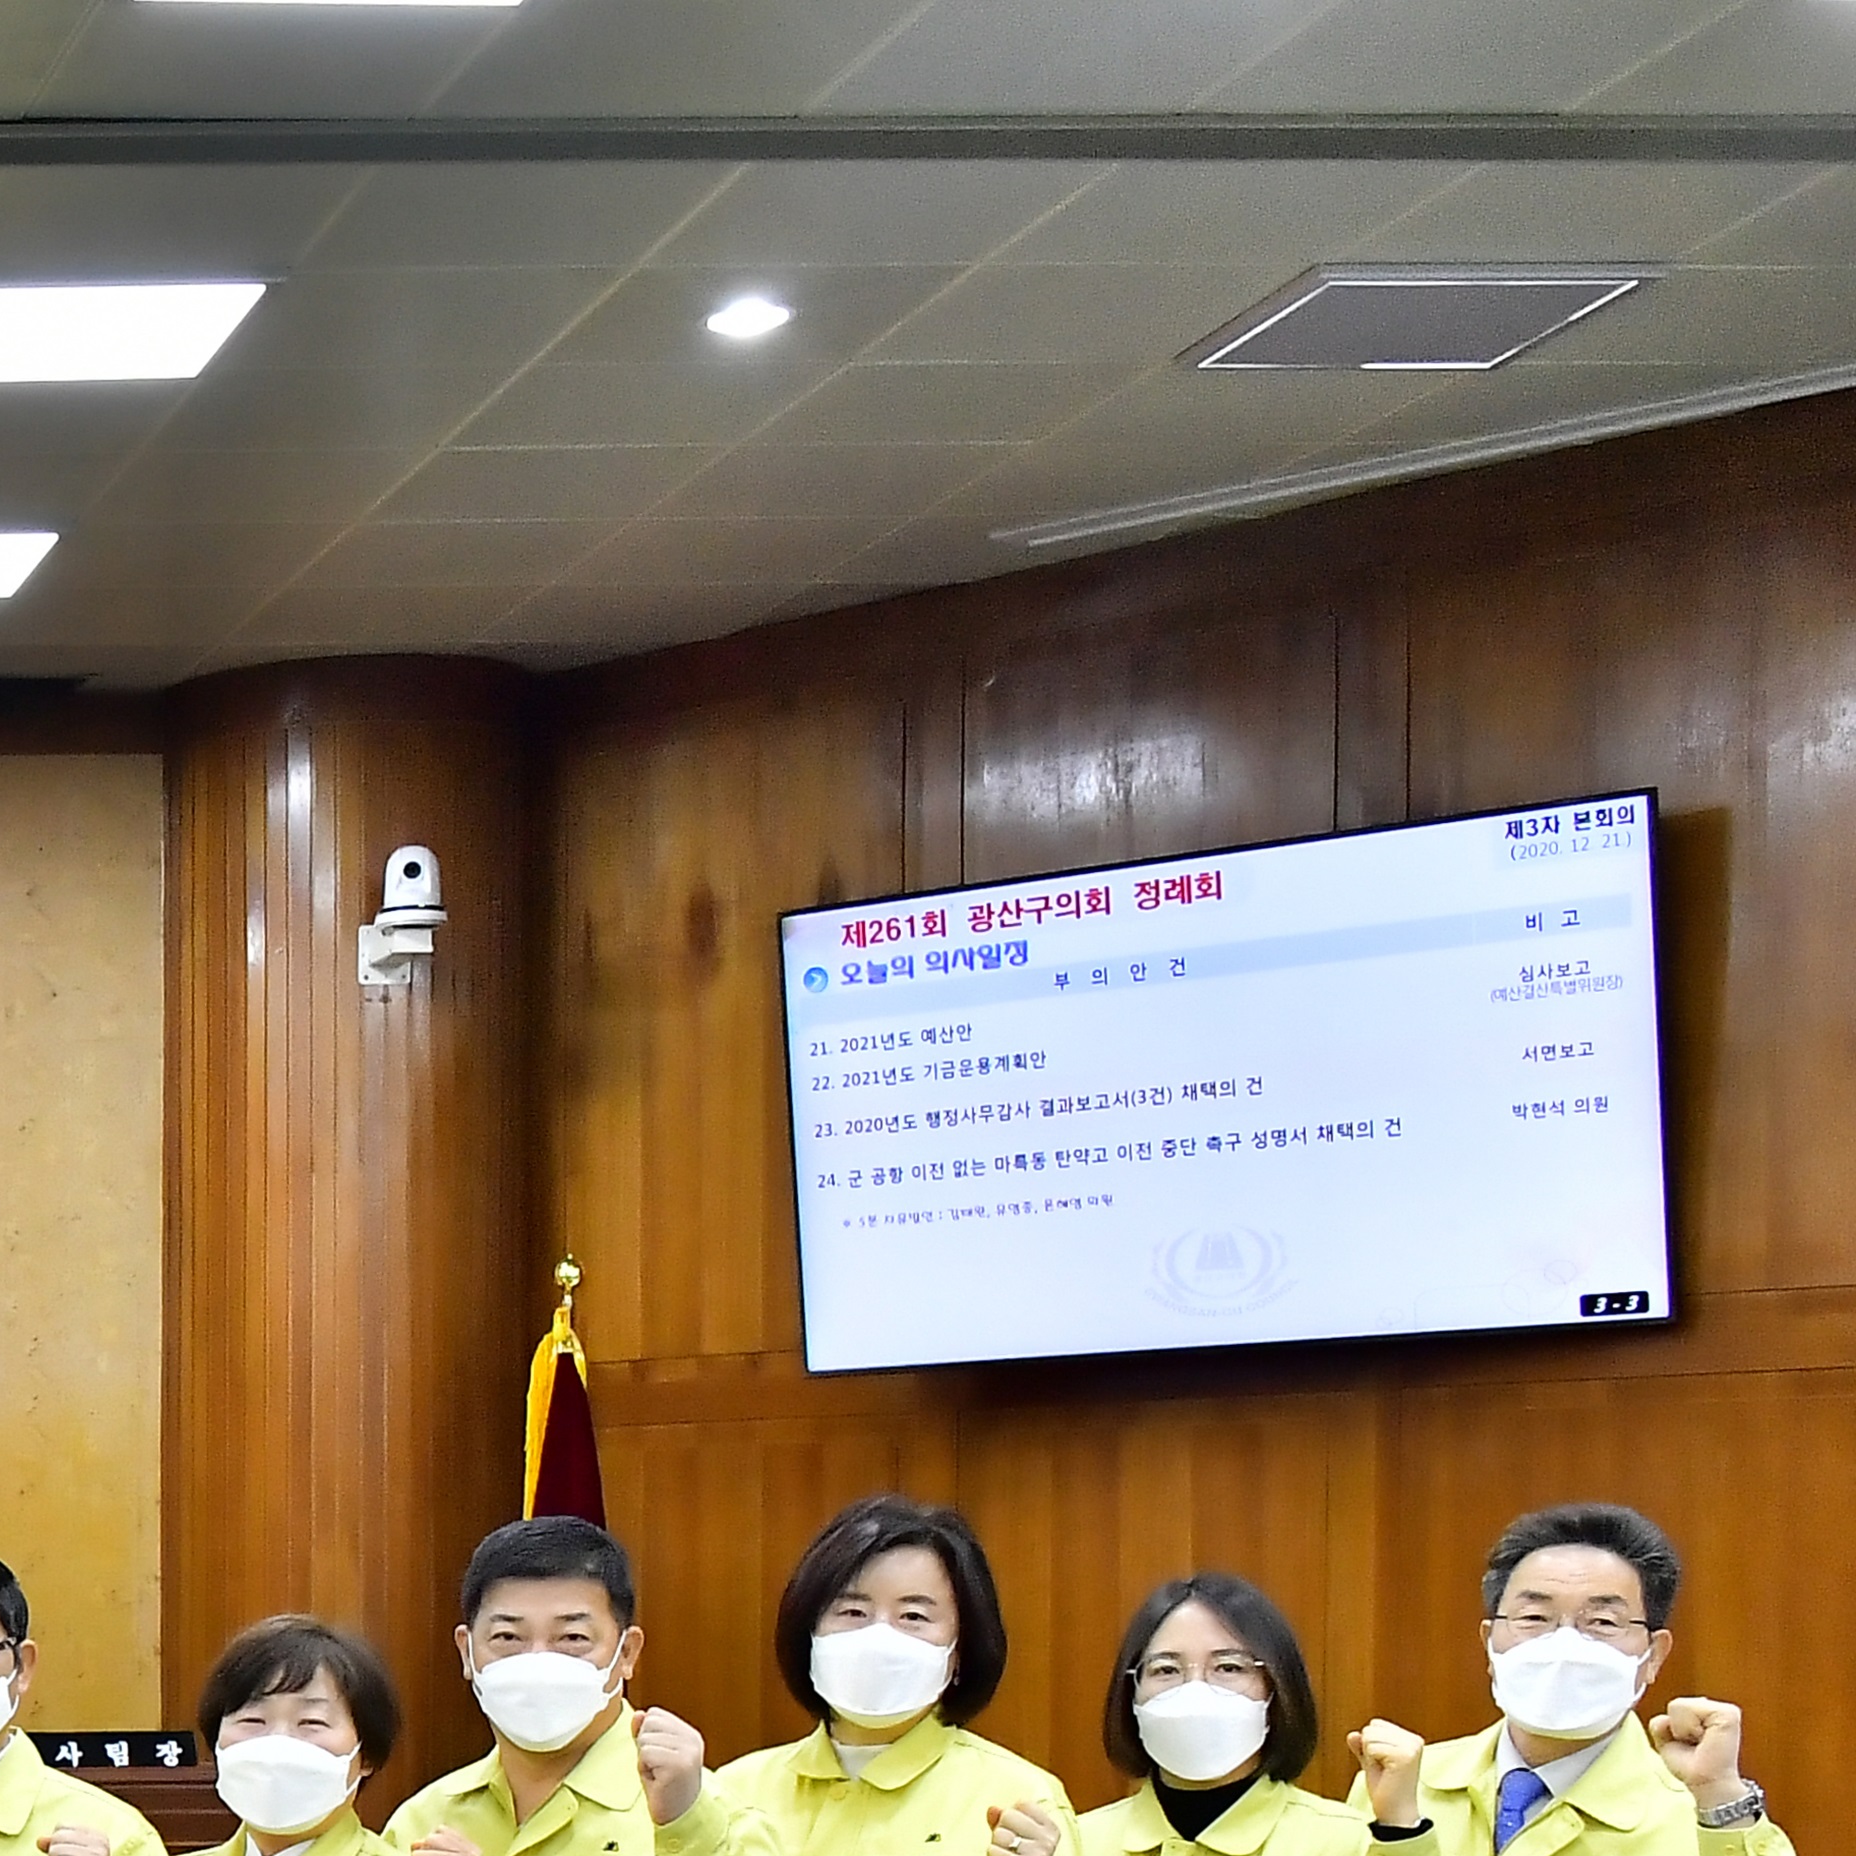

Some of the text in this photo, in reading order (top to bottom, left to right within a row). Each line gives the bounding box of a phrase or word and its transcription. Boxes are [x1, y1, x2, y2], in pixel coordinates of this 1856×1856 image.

[842, 870, 1222, 948] 제261회 광산구의회 정례회
[1526, 910, 1580, 932] 비 고
[841, 940, 1028, 985] 오늘의 의사일정
[1054, 972, 1070, 991] 부
[1130, 962, 1147, 982] 안
[1169, 957, 1185, 977] 건
[1519, 960, 1590, 984] 심사보고
[810, 1023, 972, 1056] 21. 2021년도 예산안
[1522, 1042, 1594, 1062] 서면보고
[812, 1050, 1046, 1091] 22. 2021년도 기금운용계획안
[815, 1076, 1262, 1138] 23. 2020년도 행정사무감사 결과보고서(3건) 채택의 건
[1512, 1096, 1608, 1120] 박현석 의원
[818, 1173, 840, 1188] 24.
[848, 1170, 863, 1188] 군
[871, 1167, 903, 1186] 공항
[912, 1162, 944, 1181] 이전
[953, 1158, 986, 1178] 없는
[1055, 1148, 1108, 1168] 탄약고
[1117, 1142, 1151, 1161] 이전
[1161, 1137, 1197, 1158] 중단
[1251, 1127, 1307, 1149] 성명서
[1317, 1120, 1373, 1142] 채택의
[1385, 1117, 1401, 1137] 건
